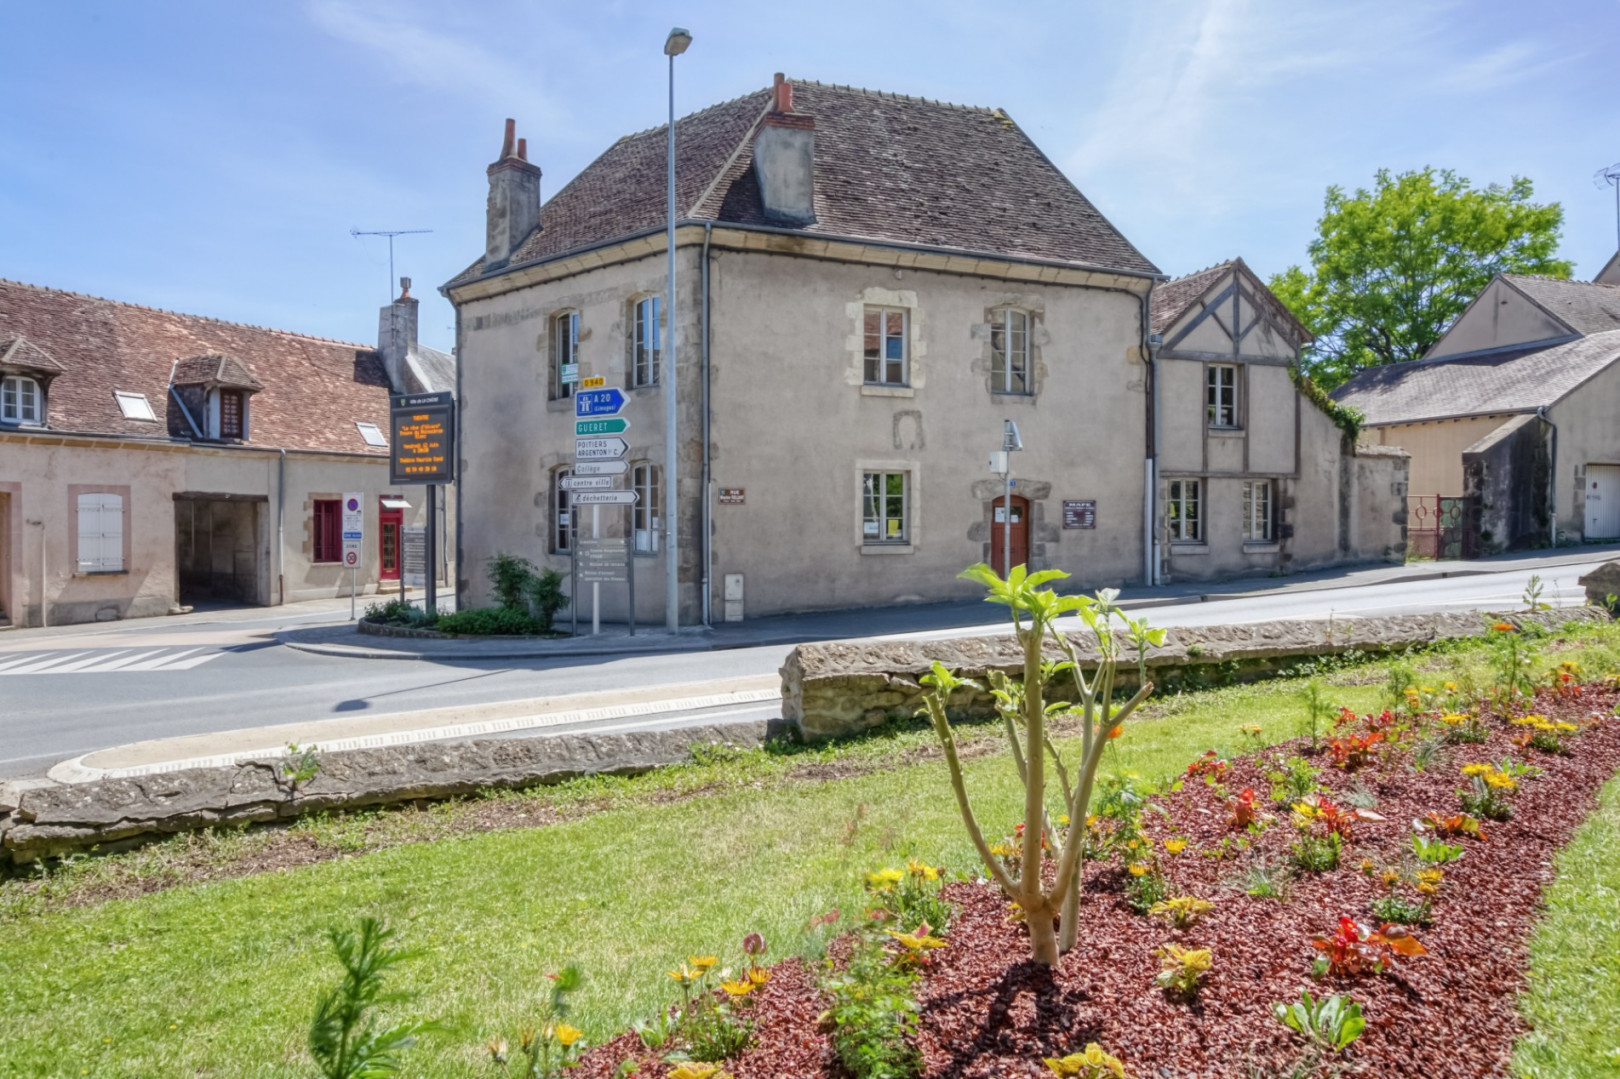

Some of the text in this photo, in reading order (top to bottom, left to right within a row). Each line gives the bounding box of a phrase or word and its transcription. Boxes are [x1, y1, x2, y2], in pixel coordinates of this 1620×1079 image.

[590, 377, 604, 386] 940
[594, 393, 611, 403] A 20
[578, 421, 608, 432] GUERET
[577, 440, 608, 449] POITIERS
[577, 449, 608, 457] ARGENTON
[573, 477, 609, 487] centre ville
